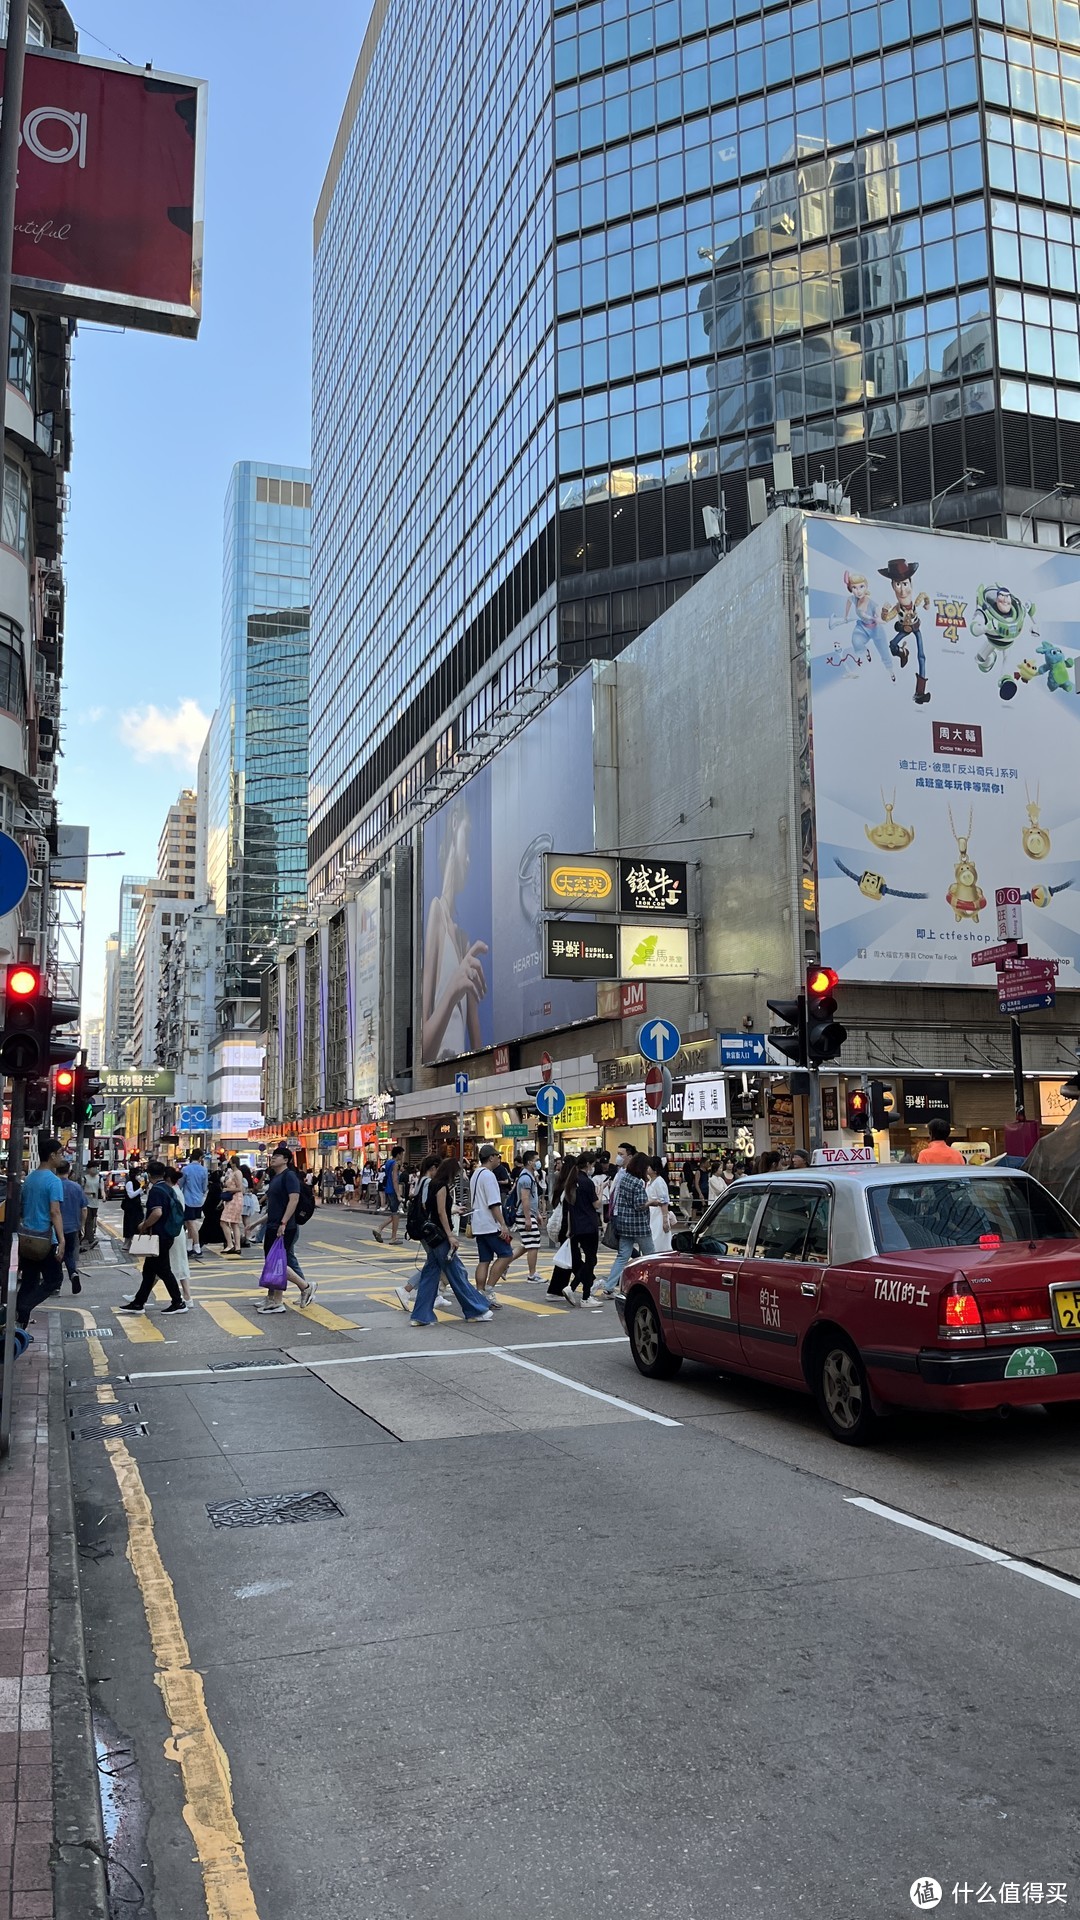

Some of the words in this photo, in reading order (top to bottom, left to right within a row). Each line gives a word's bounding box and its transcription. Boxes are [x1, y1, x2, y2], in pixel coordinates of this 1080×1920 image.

[934, 600, 968, 619] TOY
[938, 617, 964, 626] STORY
[943, 625, 959, 643] 4
[939, 727, 976, 742] 周大福
[625, 864, 674, 898] 鐵牛
[997, 910, 1007, 937] 旺角
[916, 929, 936, 940] 即上
[918, 952, 934, 961] Chow
[944, 953, 958, 961] Fook
[623, 982, 644, 1007] JM
[495, 1047, 508, 1066] JM
[106, 1074, 156, 1087] 植物醫生
[822, 1147, 871, 1162] TAXI
[760, 1287, 779, 1308] 的士
[760, 1306, 780, 1328] TAXI
[1016, 1348, 1045, 1358] TAXI
[1025, 1355, 1035, 1368] 4
[1017, 1367, 1046, 1376] SEATS
